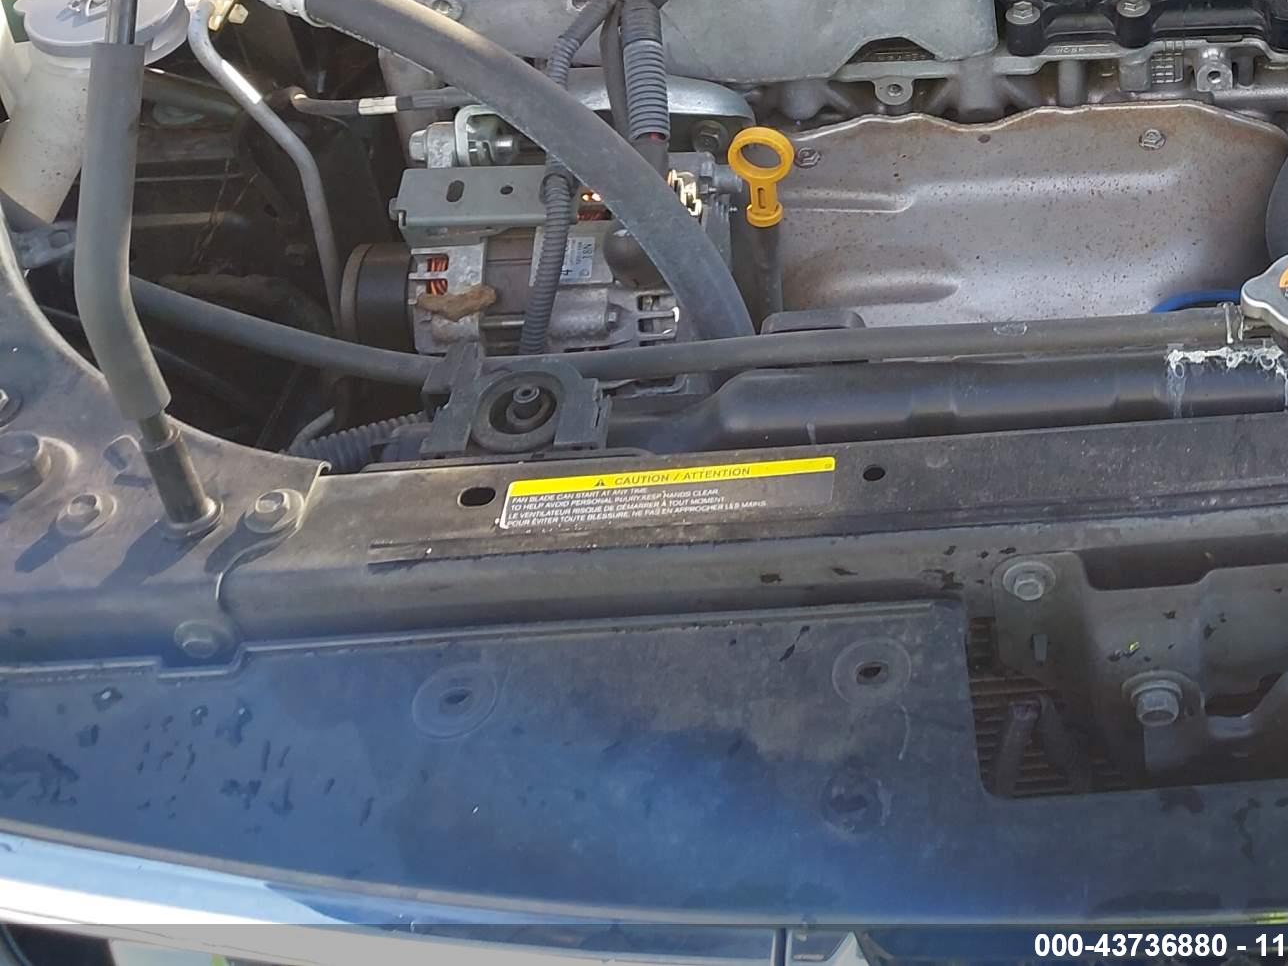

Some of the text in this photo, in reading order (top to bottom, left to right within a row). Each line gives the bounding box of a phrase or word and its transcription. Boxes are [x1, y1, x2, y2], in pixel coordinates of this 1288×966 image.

[615, 474, 669, 485] CAUTION
[682, 467, 751, 480] ATTENTION
[512, 496, 528, 504] FAN
[529, 494, 555, 503] BLADE
[575, 491, 601, 499] START
[523, 502, 544, 510] HELP
[544, 500, 569, 508] AVOID
[570, 497, 612, 507] PERSONAL
[663, 490, 691, 499] HANDS
[507, 519, 530, 527] POUR
[531, 516, 559, 525] ÉVITER
[560, 514, 586, 523] TOUTE
[644, 508, 661, 516] PAS
[661, 507, 673, 515] EN
[673, 503, 724, 513] APPROCHER
[520, 507, 571, 518] VENTILATEUR
[571, 505, 602, 514] RISQUE
[603, 504, 615, 512] DE
[669, 498, 690, 507] TOUT
